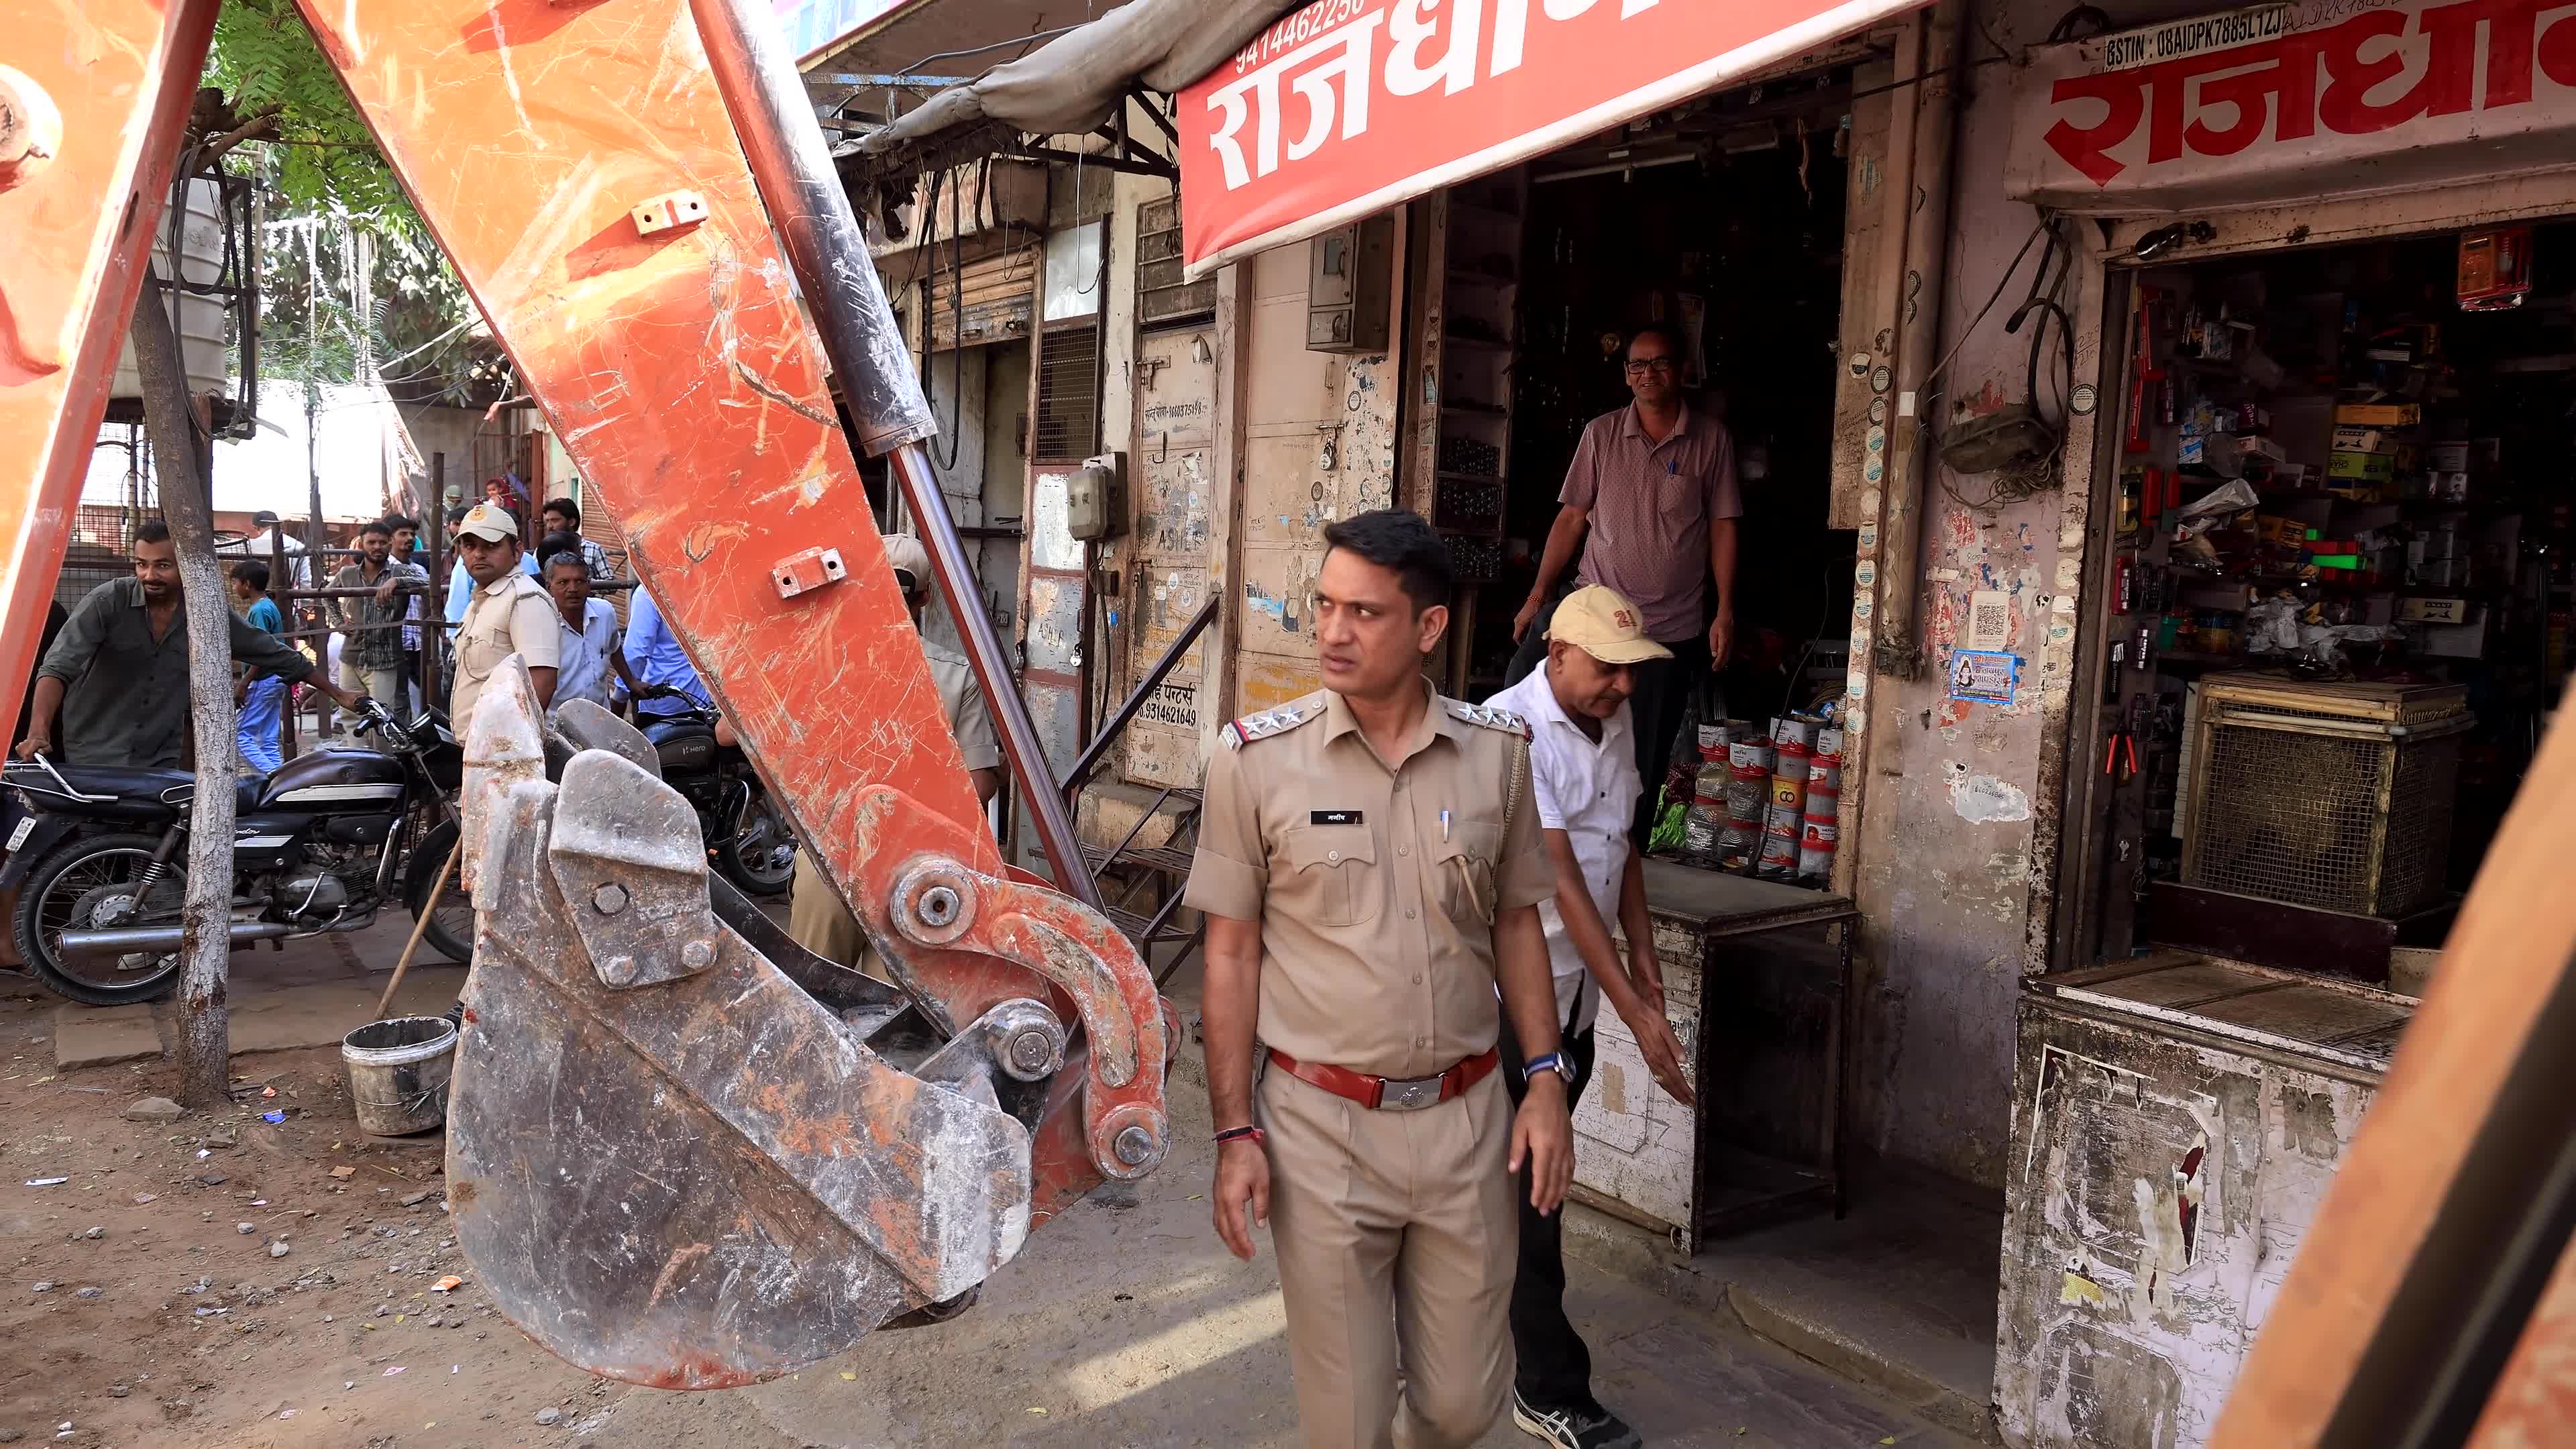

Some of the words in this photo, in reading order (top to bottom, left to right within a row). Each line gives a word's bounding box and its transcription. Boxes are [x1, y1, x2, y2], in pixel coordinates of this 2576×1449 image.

[1208, 0, 1662, 192] राजधा
[2106, 34, 2145, 66] GSTIN
[2156, 7, 2281, 58] 08AIDPK7885L1ZJ
